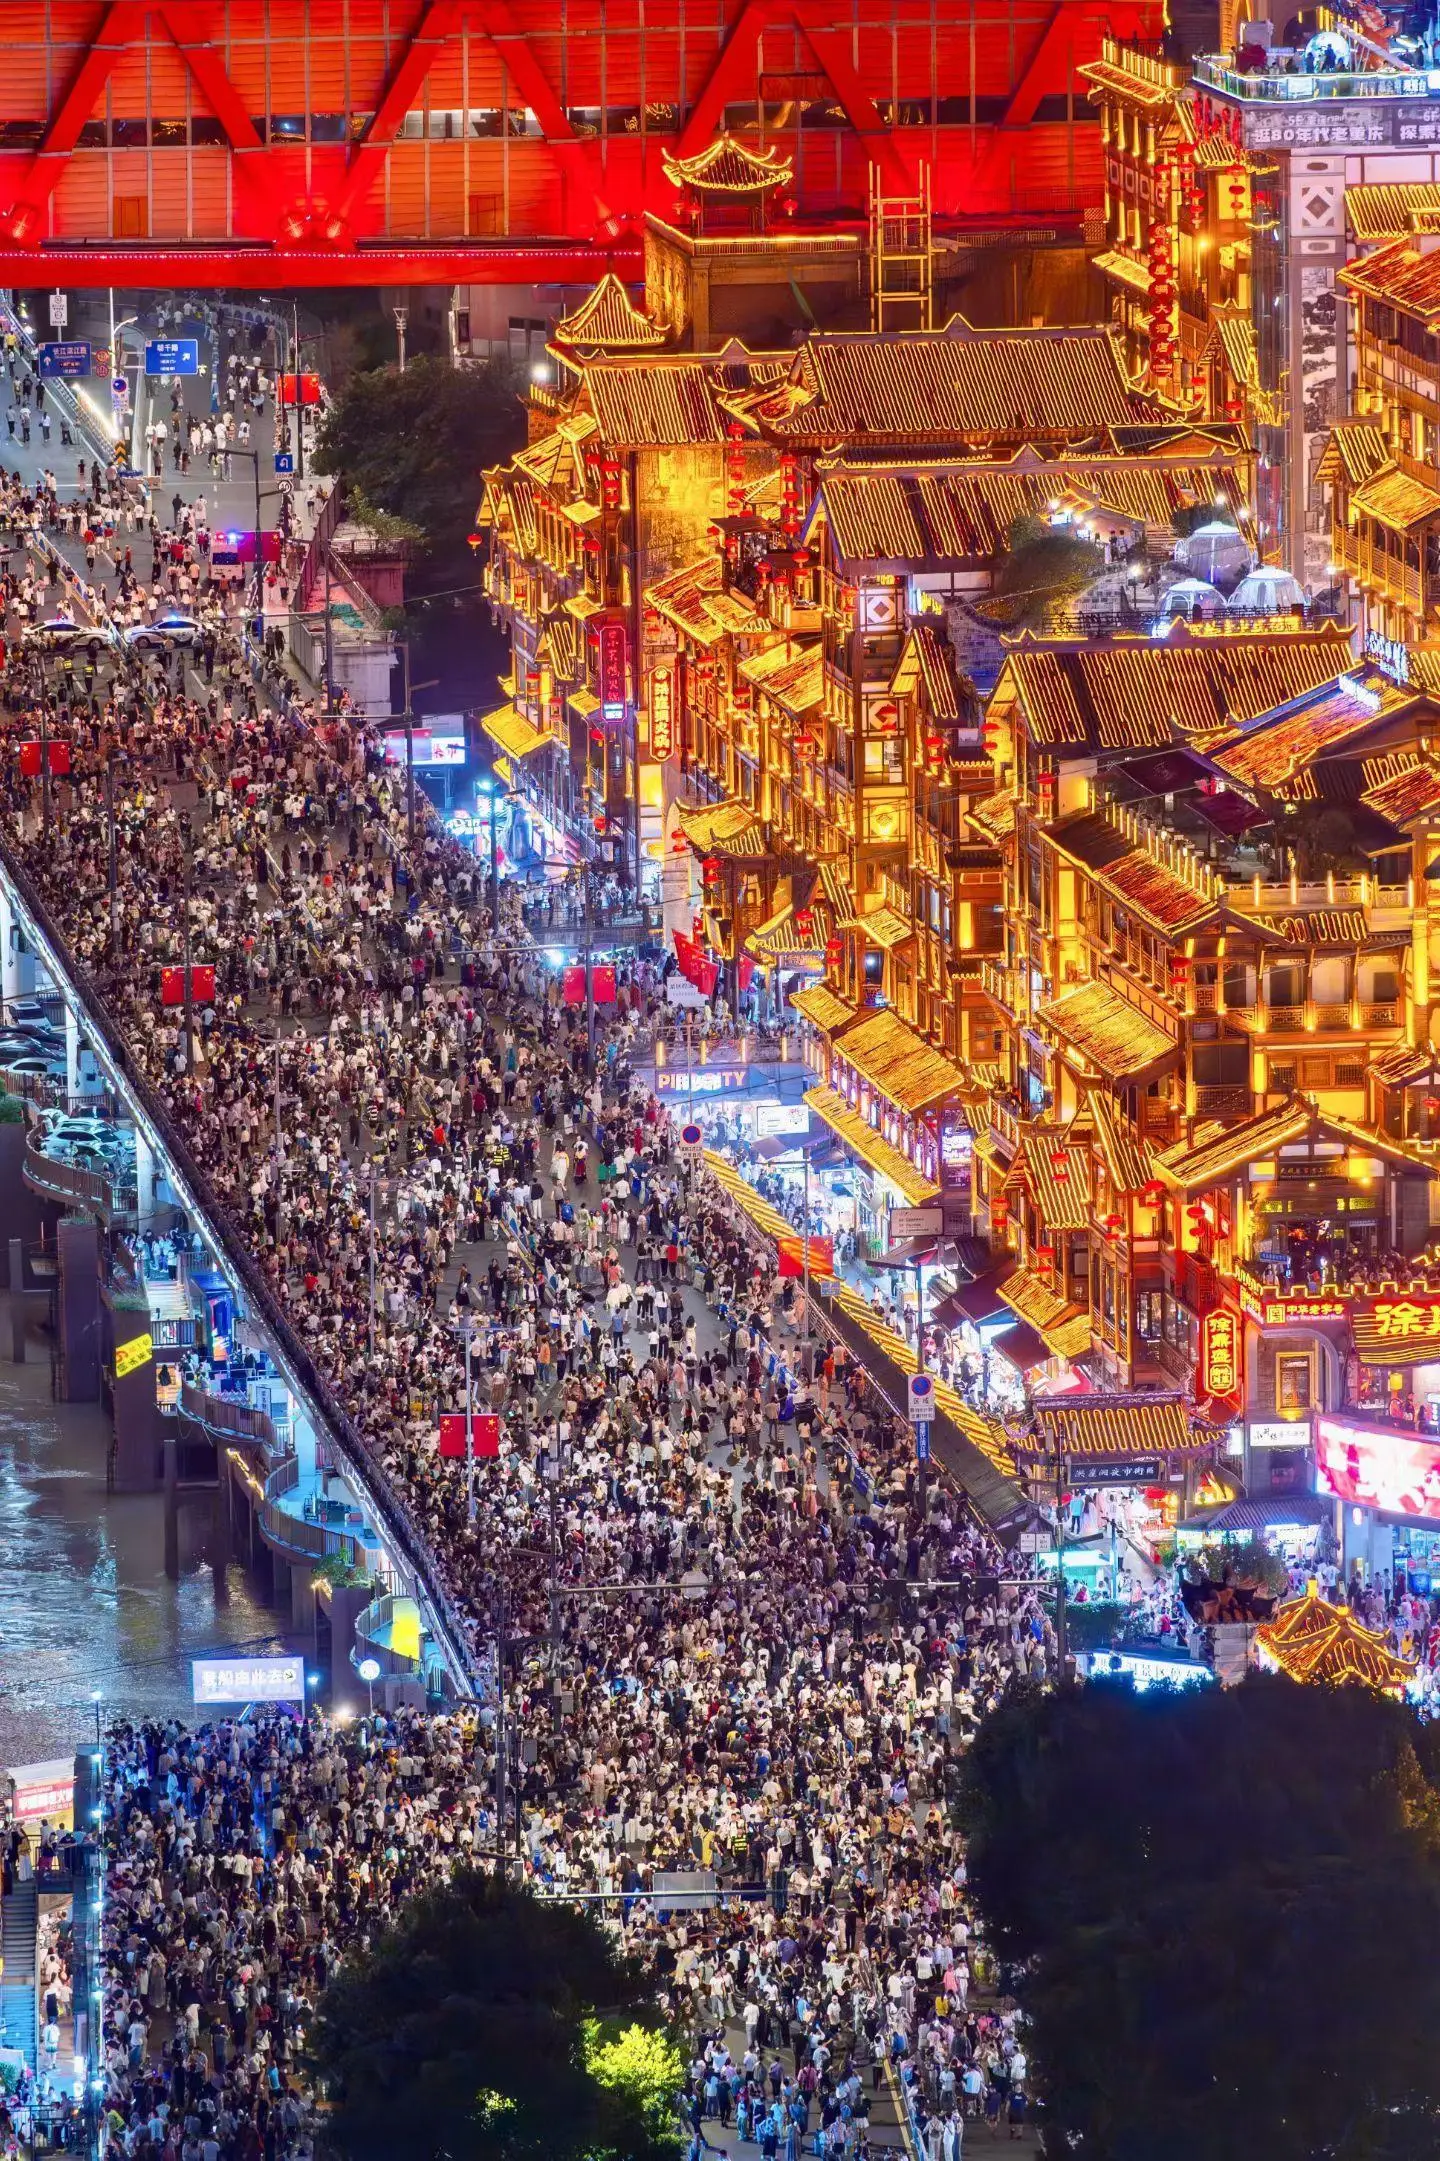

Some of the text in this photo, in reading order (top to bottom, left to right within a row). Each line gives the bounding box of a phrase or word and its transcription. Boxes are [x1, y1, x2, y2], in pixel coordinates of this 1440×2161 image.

[1399, 124, 1440, 140] 探索
[1286, 1304, 1345, 1315] 中华老字号
